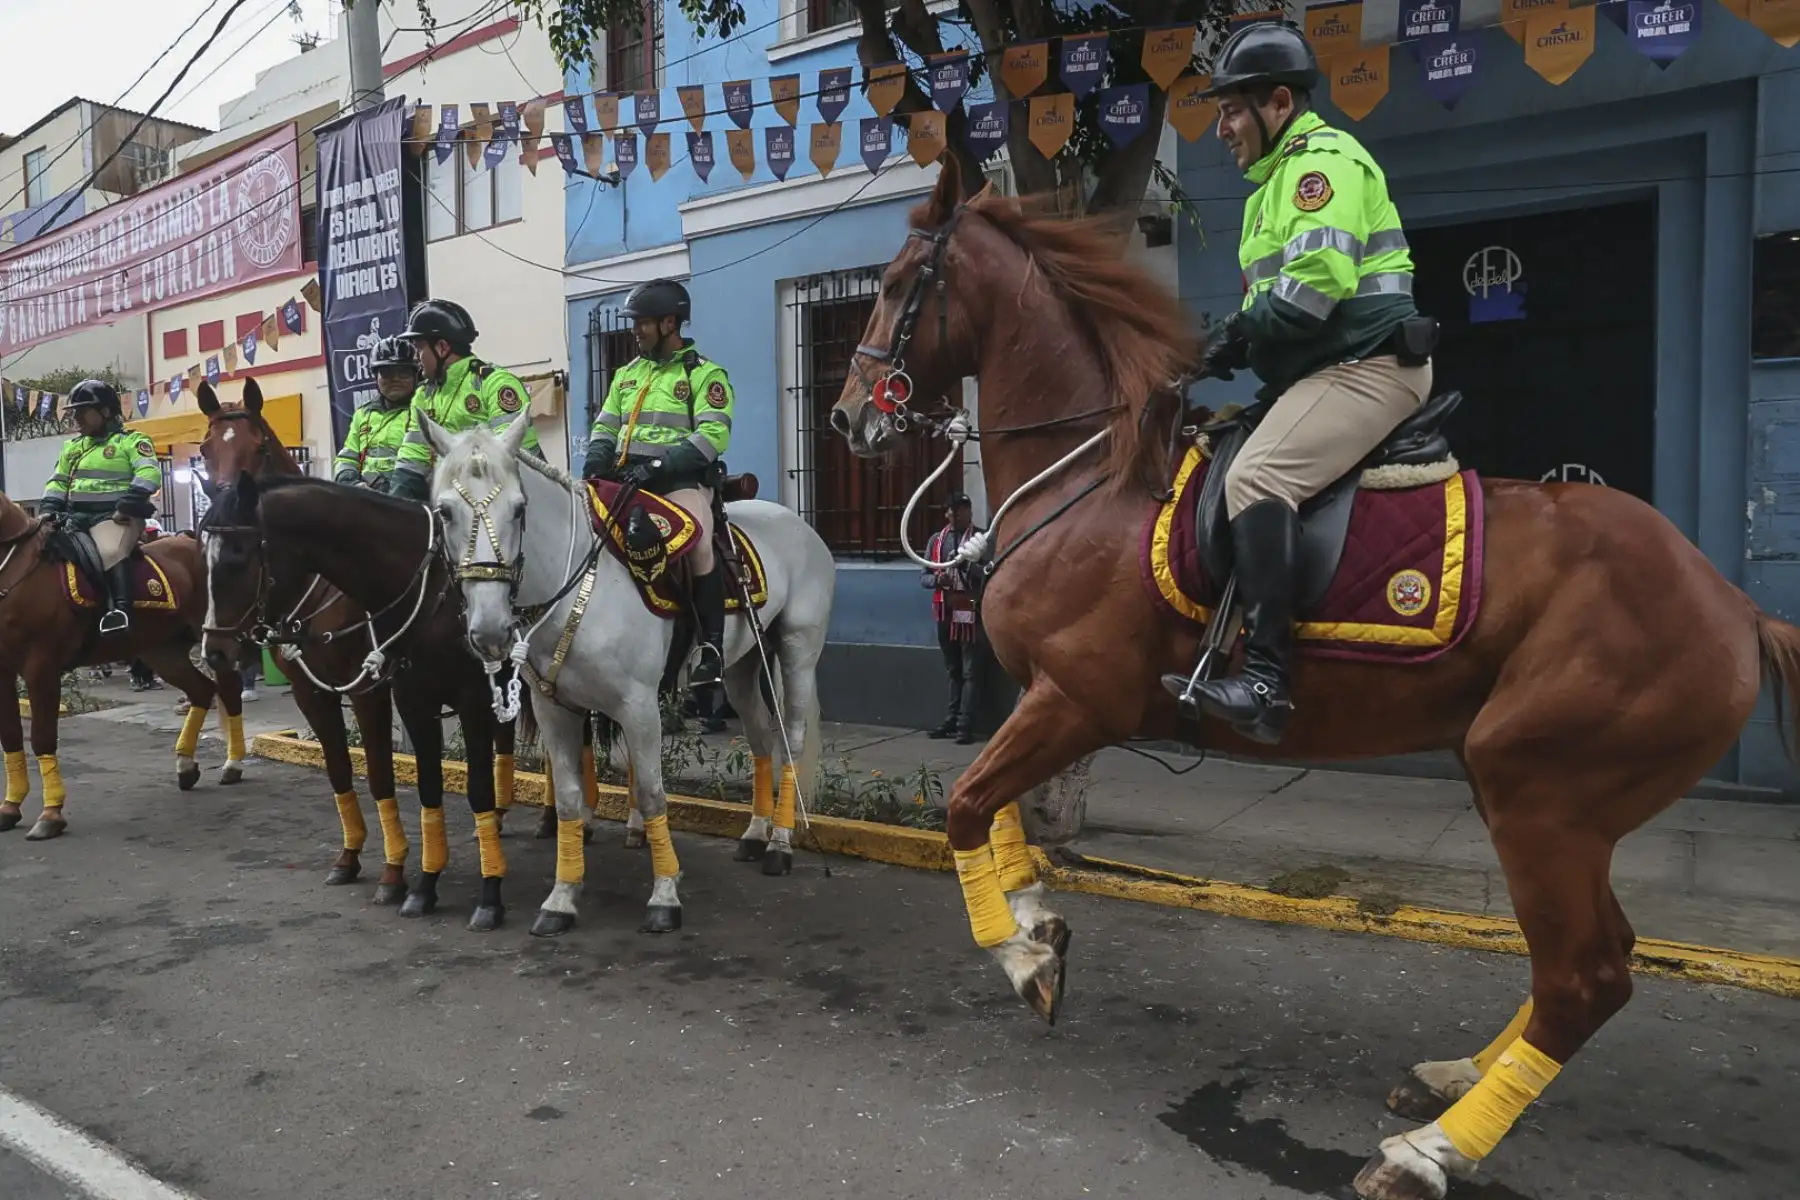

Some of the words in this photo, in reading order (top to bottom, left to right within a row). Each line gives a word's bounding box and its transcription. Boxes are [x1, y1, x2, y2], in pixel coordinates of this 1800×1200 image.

[1412, 9, 1446, 23] CREER
[1644, 9, 1684, 25] CREER
[1536, 31, 1583, 48] CRISTAL
[1434, 52, 1468, 68] CREER
[1340, 71, 1379, 86] CRISTAL
[329, 210, 345, 239] ES
[385, 194, 400, 225] LO
[329, 228, 401, 271] REALMENTE
[380, 262, 398, 291] ES
[9, 284, 88, 346] GARGANTA
[94, 276, 103, 318] Y
